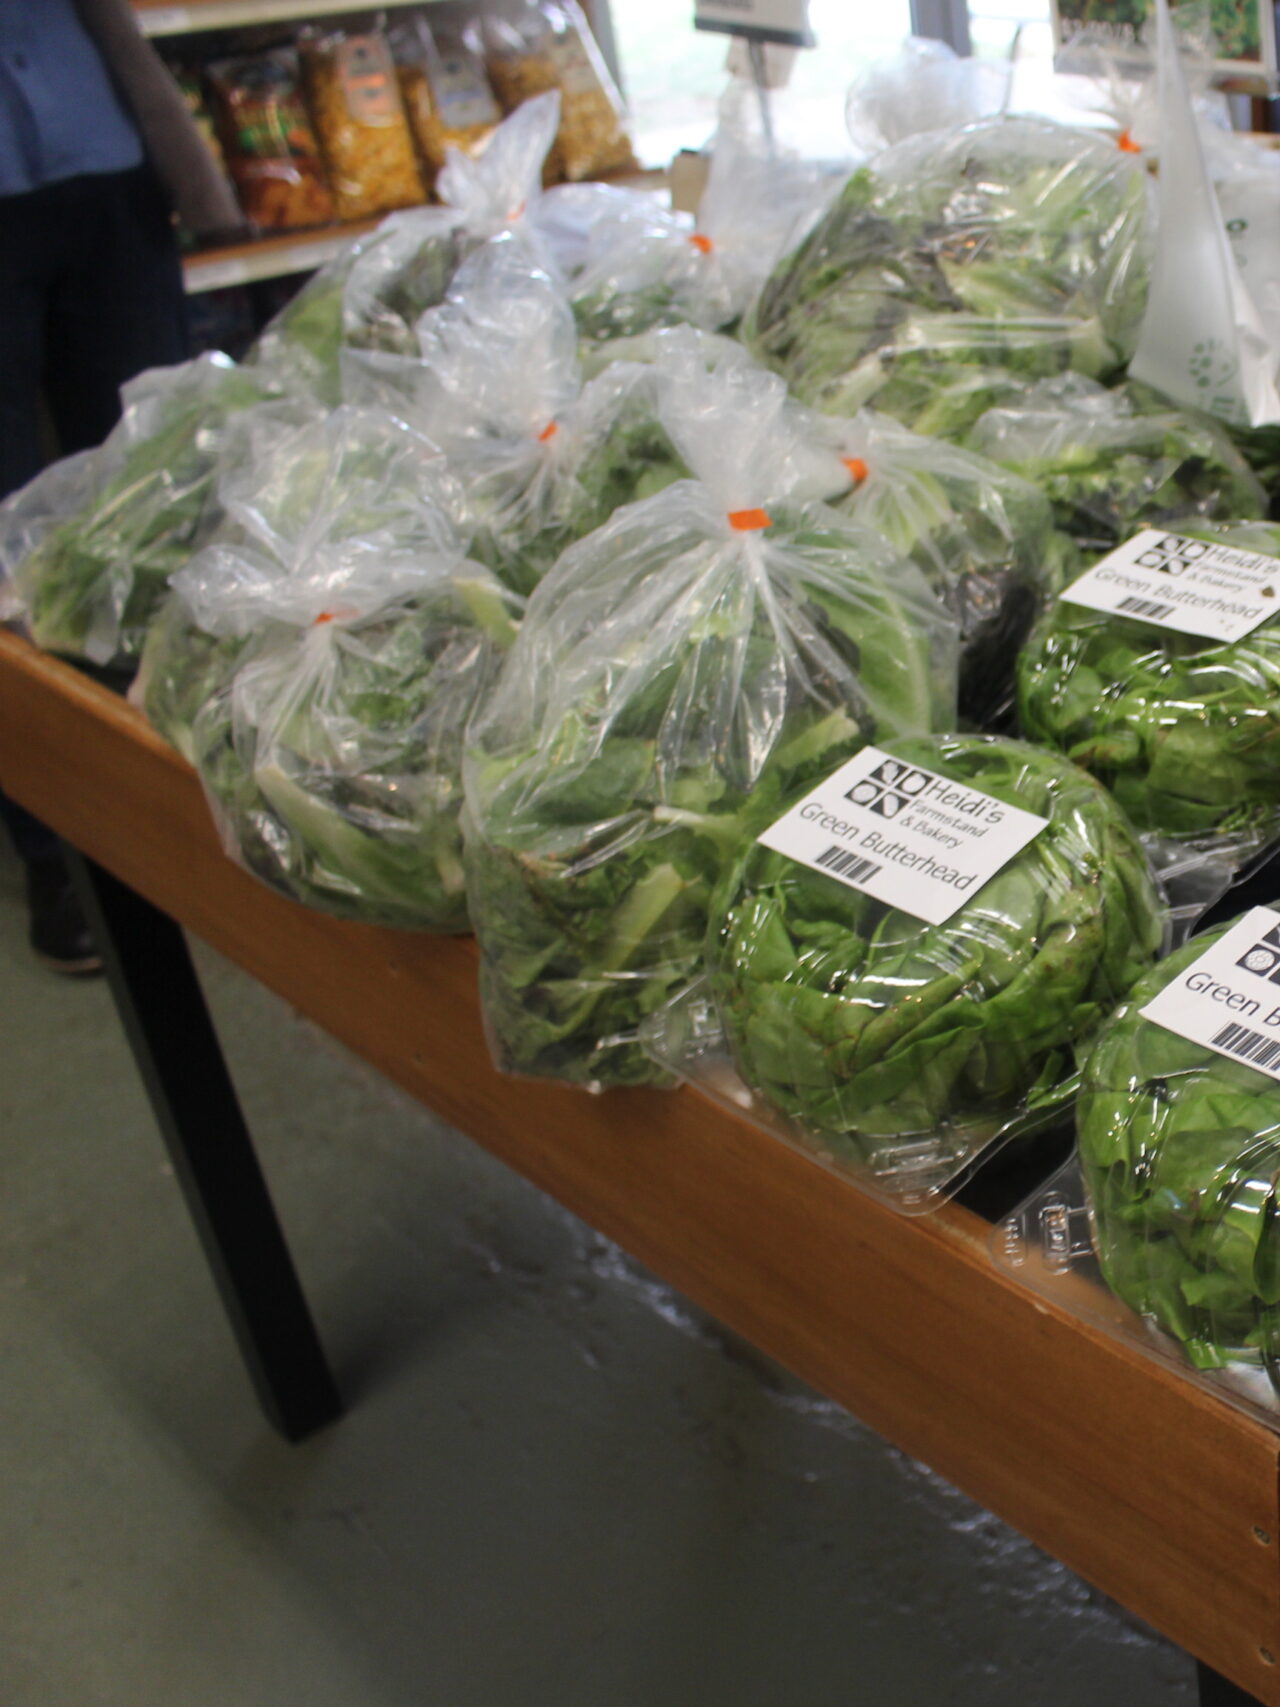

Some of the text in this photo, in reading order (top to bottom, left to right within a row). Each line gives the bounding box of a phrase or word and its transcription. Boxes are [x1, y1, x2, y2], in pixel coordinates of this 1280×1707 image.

[1205, 545, 1280, 574] Heidi's
[1095, 568, 1264, 619] Green Butterhead
[908, 799, 990, 839] Farmstand
[923, 780, 1006, 825] Heidi's
[799, 802, 979, 891] Green Butterhead
[900, 815, 964, 850] & Bakery
[1185, 972, 1260, 1017] Green
